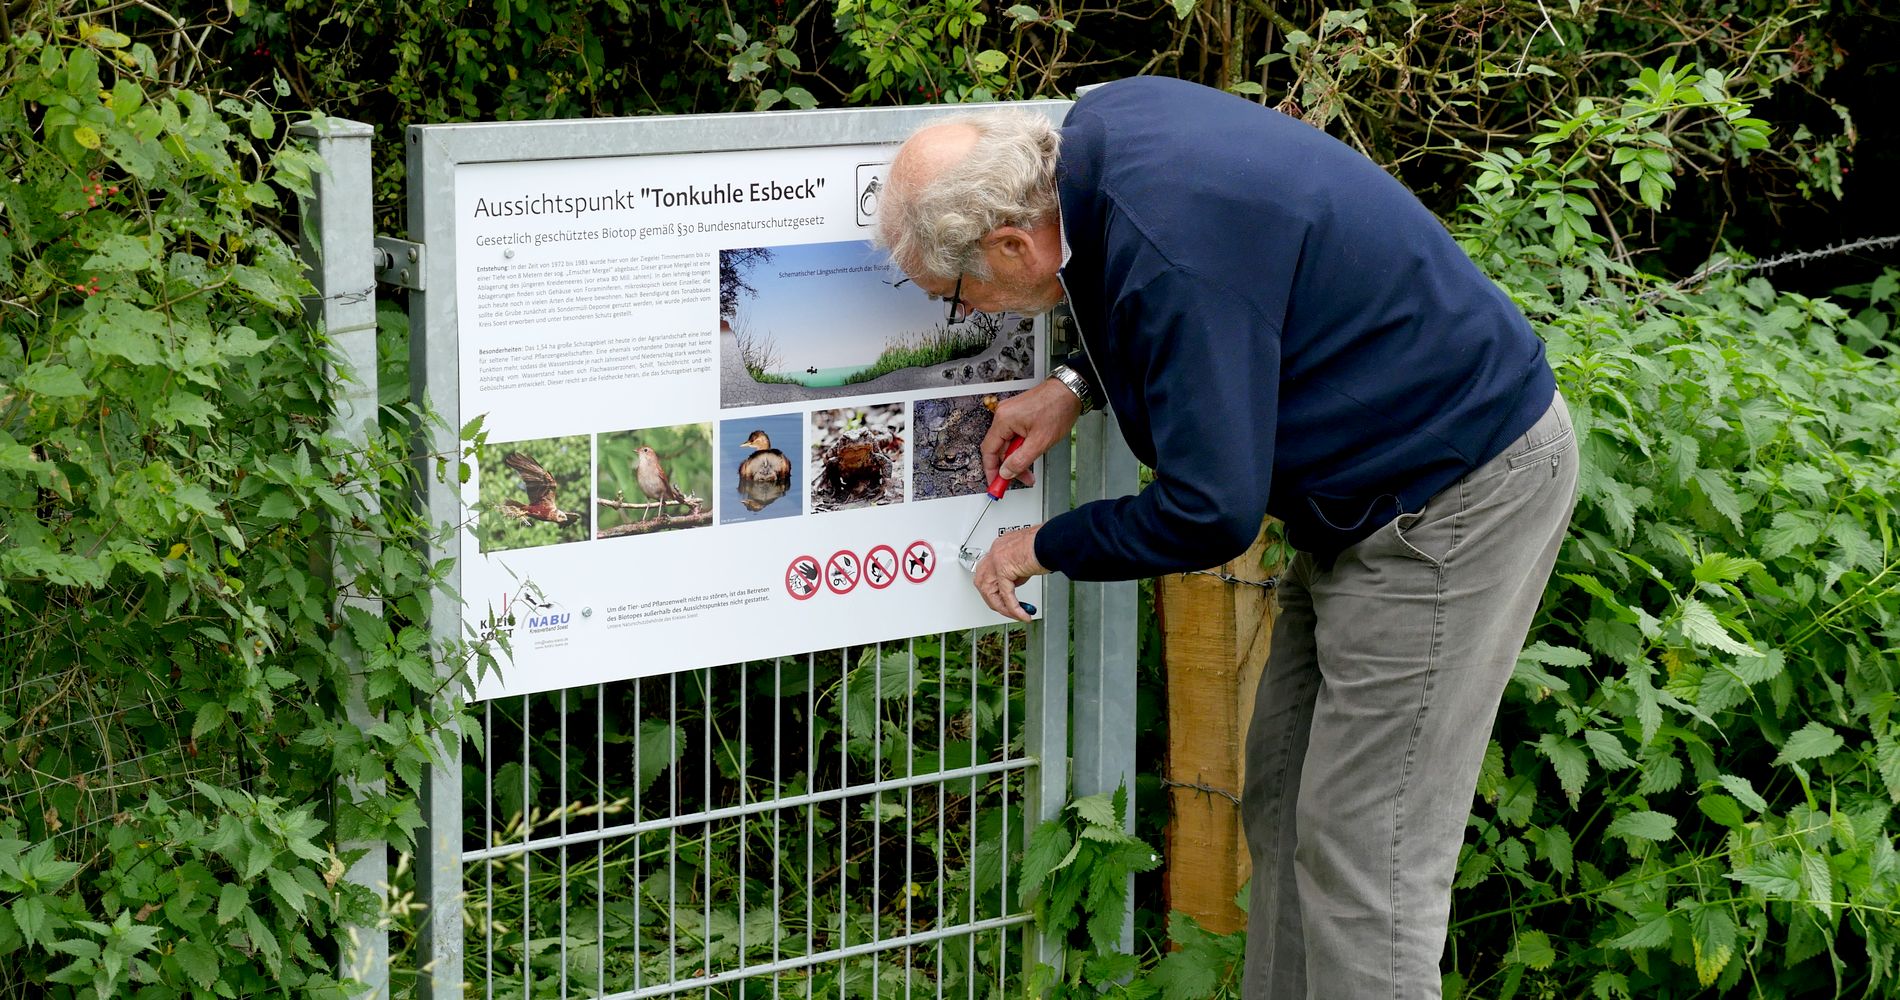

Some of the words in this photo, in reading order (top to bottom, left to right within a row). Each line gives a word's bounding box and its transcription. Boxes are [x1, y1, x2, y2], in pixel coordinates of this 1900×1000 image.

[474, 189, 635, 218] Aussichtspunkt
[641, 184, 744, 209] "Tonkuhle
[750, 179, 825, 203] Esbeck"
[476, 231, 532, 246] Gesetzlich
[535, 227, 599, 246] geschütztes
[602, 225, 637, 240] Biotop
[639, 222, 675, 239] gemäß
[677, 221, 695, 237] §30
[697, 213, 825, 232] Bundesnaturschutzgesetz
[528, 613, 570, 628] NABU
